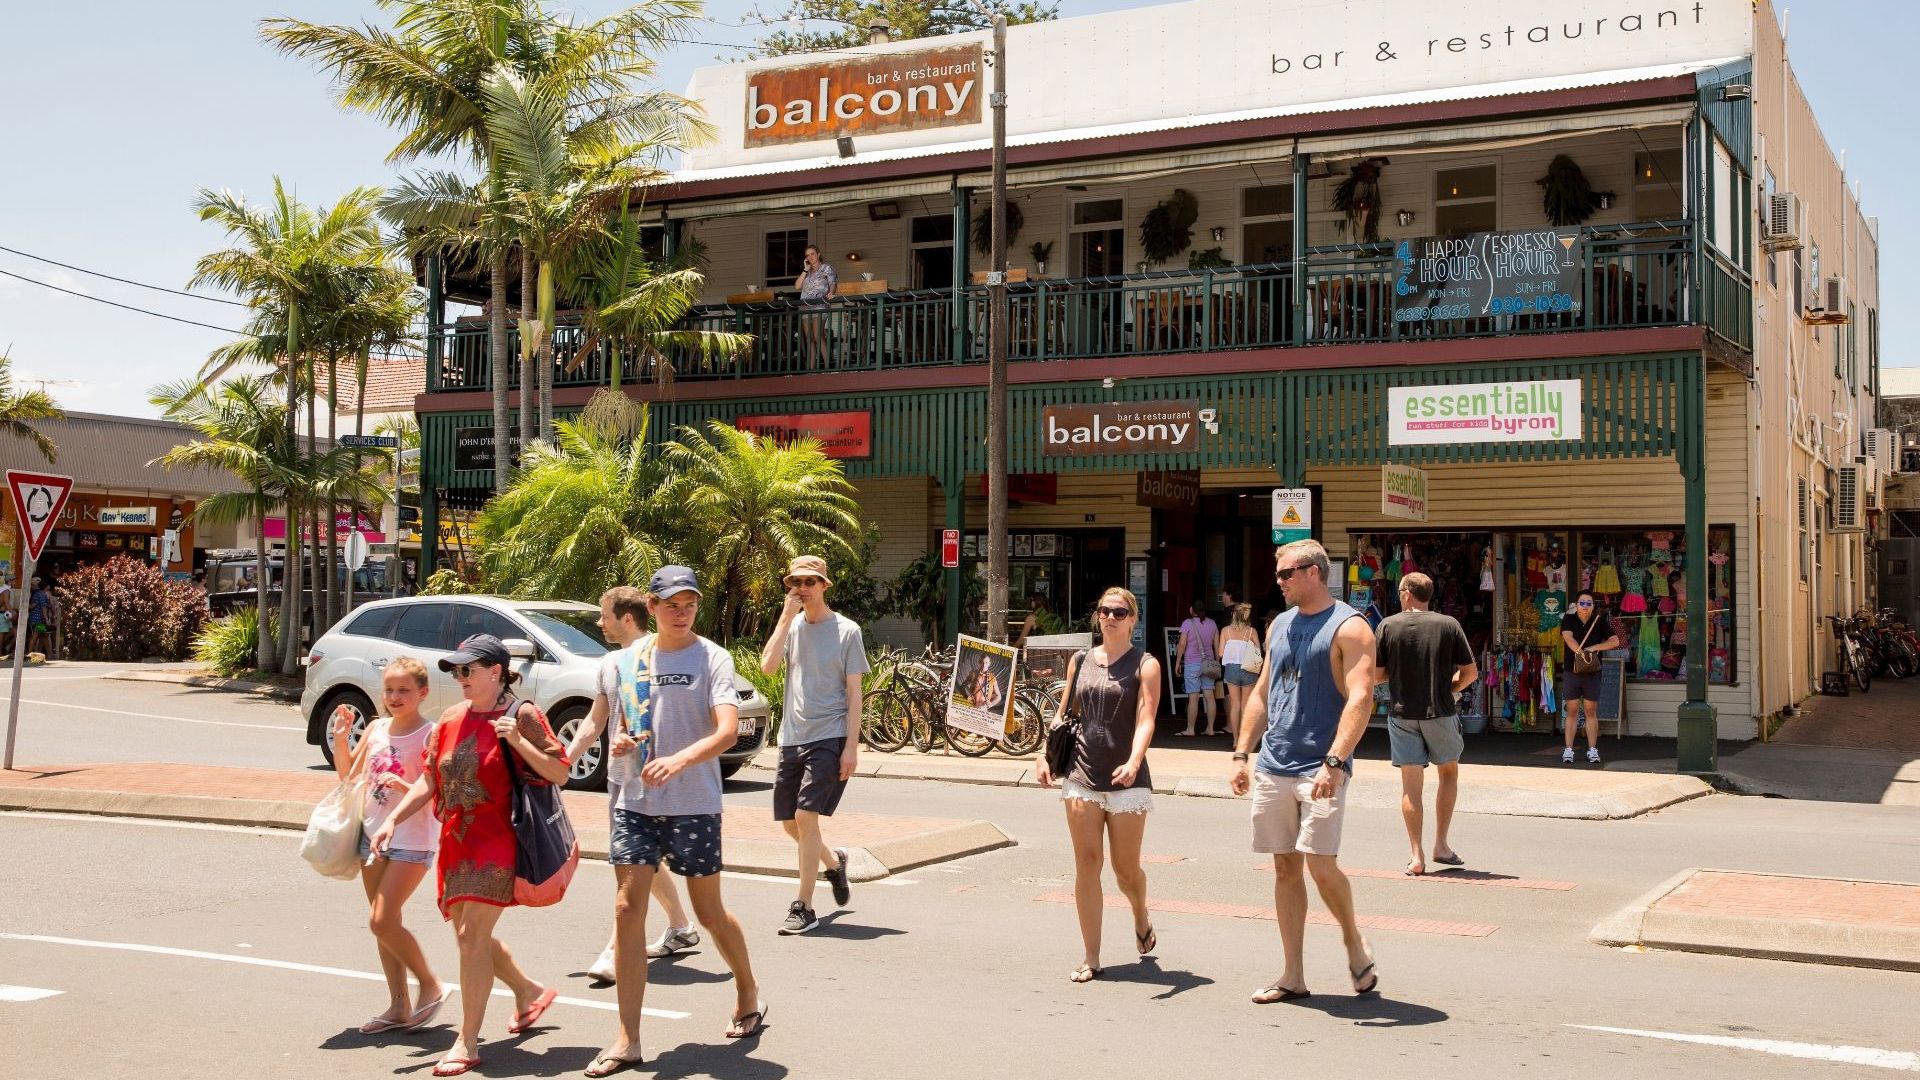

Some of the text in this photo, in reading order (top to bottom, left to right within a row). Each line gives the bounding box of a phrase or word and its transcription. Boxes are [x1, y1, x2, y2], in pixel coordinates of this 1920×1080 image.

[1272, 2, 1704, 75] bar & restaurant
[867, 61, 977, 85] bar & restaurant
[748, 78, 975, 130] balcony
[1425, 239, 1475, 259] HAPPY
[1491, 232, 1556, 254] ESPRESSO
[1420, 255, 1483, 283] HOUR
[1496, 250, 1560, 278] HOUR
[1428, 289, 1446, 299] MON
[1515, 282, 1534, 294] SUN
[1395, 302, 1471, 322] 66809666
[1117, 411, 1191, 422] bar & restaurant
[1405, 384, 1563, 438] essentially
[1049, 414, 1190, 445] balcony
[1425, 421, 1447, 429] stuff
[1491, 415, 1555, 435] byron
[346, 436, 394, 446] SERVICES CLUB
[460, 438, 479, 447] JOHN
[1142, 470, 1199, 507] balcony
